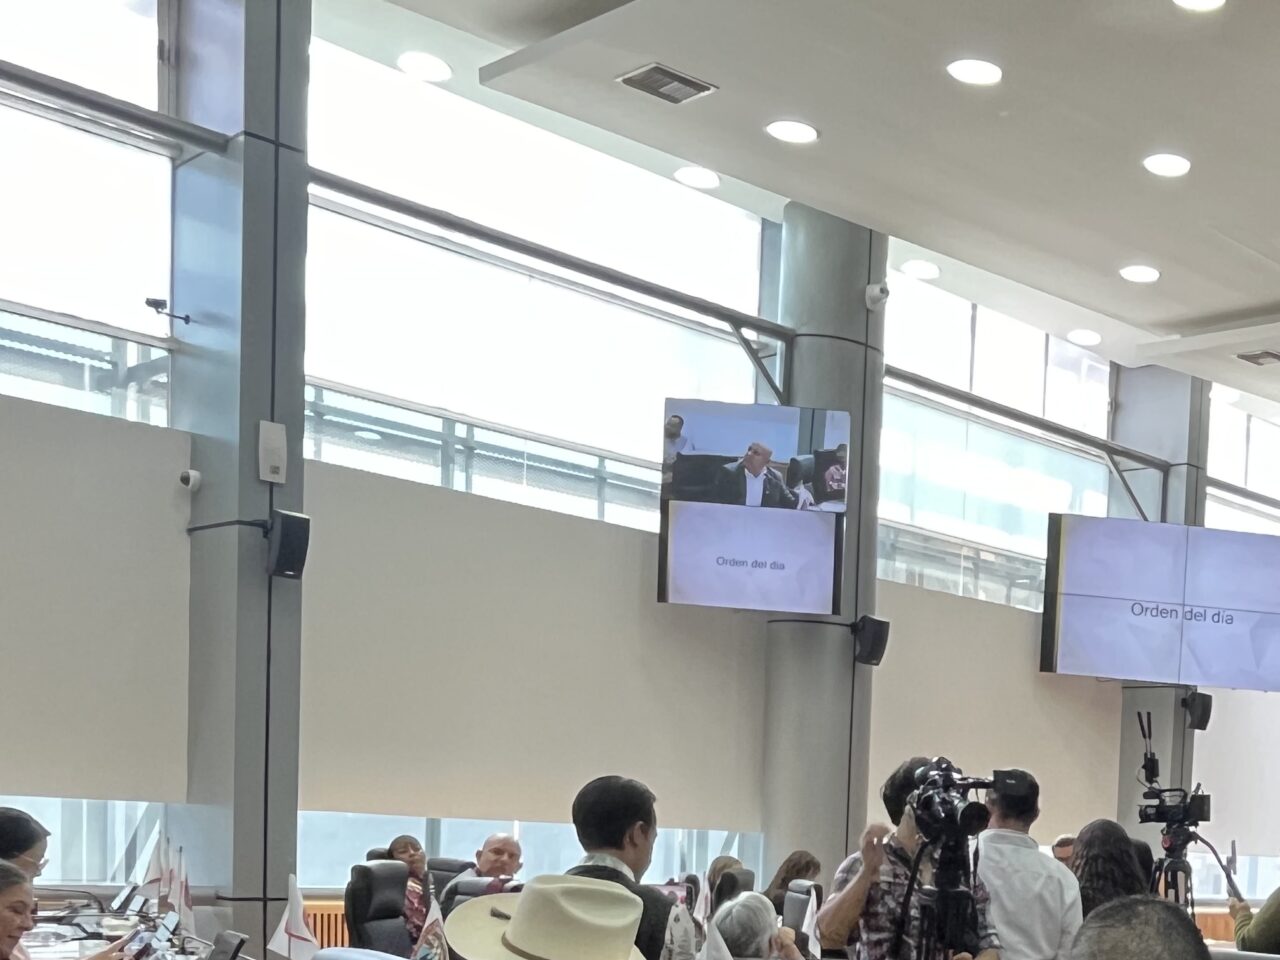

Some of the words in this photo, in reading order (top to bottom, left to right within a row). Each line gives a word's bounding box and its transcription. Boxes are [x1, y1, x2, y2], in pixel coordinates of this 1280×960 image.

[716, 556, 749, 568] Orden
[751, 559, 767, 569] del
[1131, 602, 1178, 620] Orden
[1184, 609, 1207, 623] del
